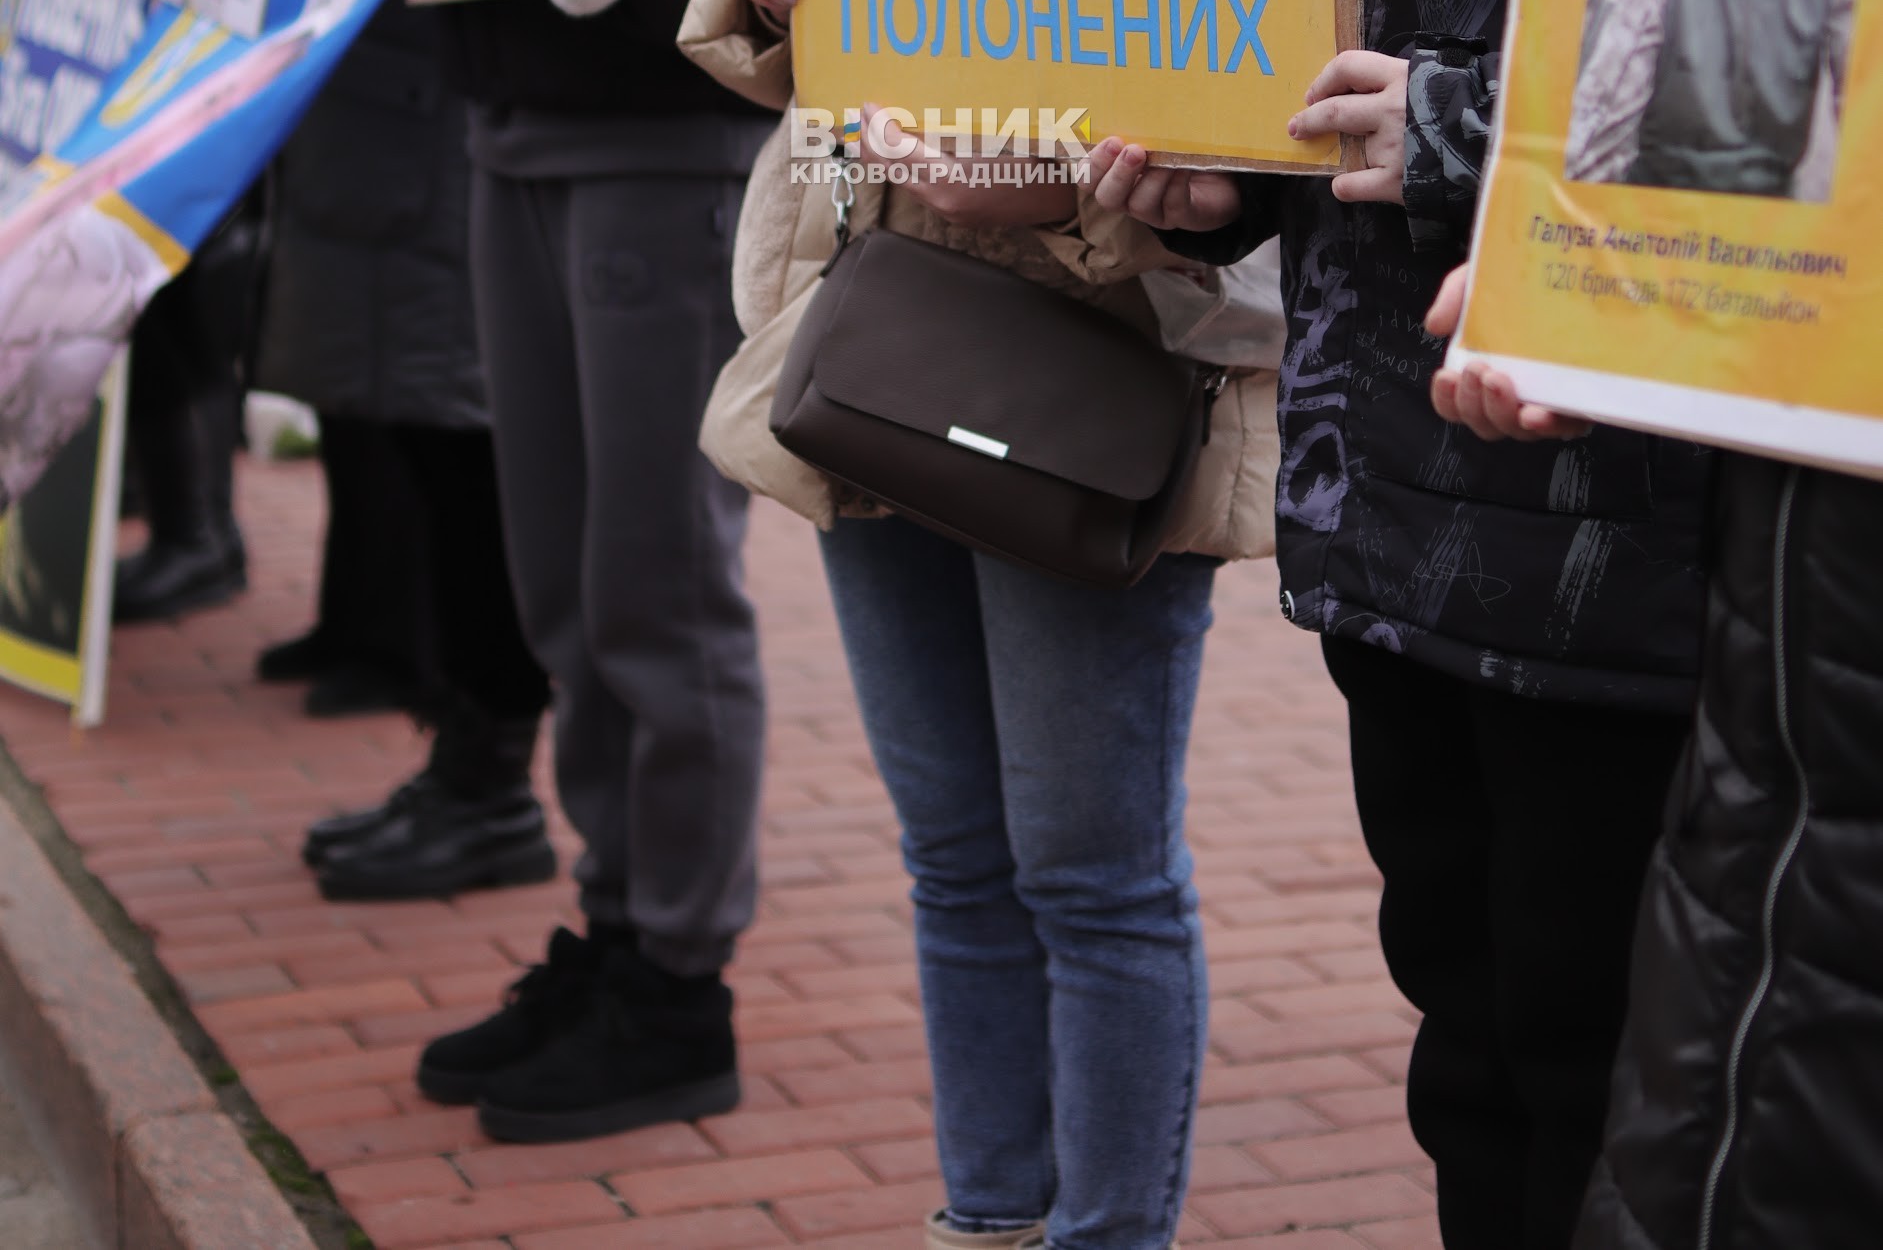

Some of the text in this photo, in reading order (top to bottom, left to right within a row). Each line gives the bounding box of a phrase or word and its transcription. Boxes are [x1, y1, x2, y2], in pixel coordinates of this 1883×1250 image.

[1528, 214, 1848, 280] Галуза Анатолій Васильович
[1544, 261, 1578, 292] 120
